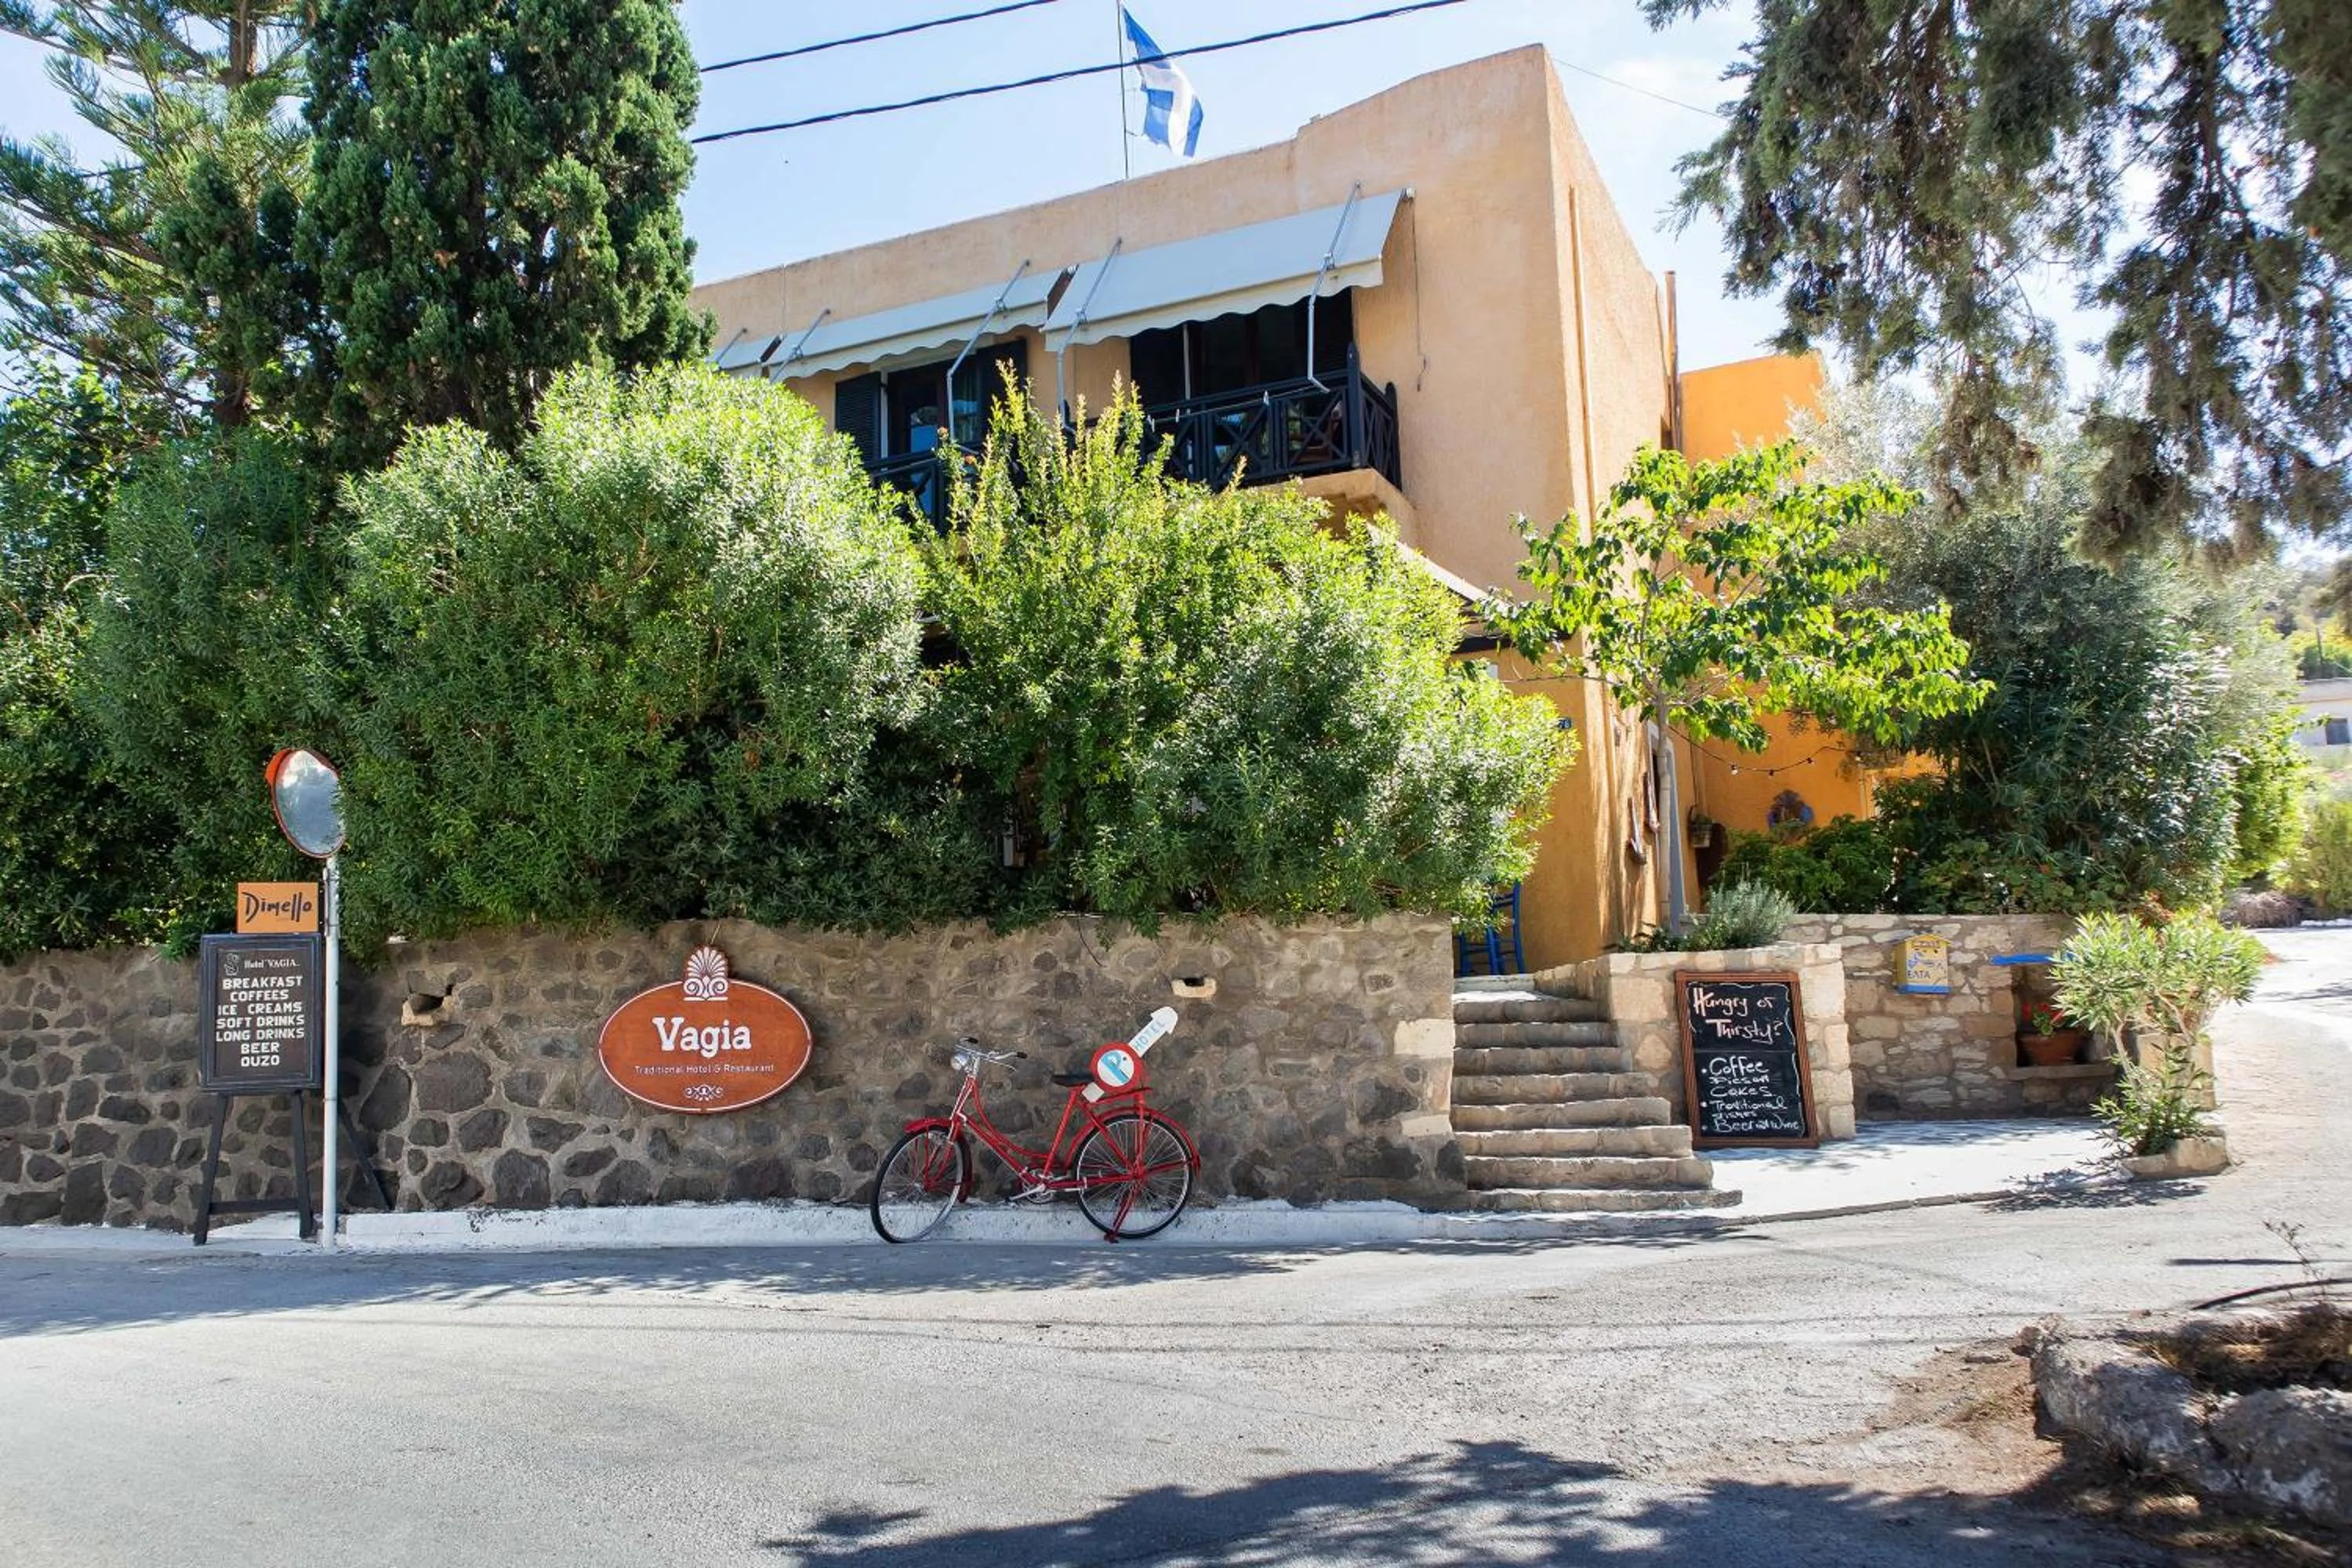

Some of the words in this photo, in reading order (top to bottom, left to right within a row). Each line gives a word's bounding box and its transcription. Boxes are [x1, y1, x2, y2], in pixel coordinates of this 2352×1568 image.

[241, 891, 313, 923] Dimello
[244, 959, 264, 969] Hotel
[222, 976, 303, 989] BREAKFAST
[230, 989, 289, 1002] COFFEES
[1693, 987, 1748, 1017] Hungry
[1757, 996, 1777, 1009] or
[217, 1004, 238, 1015] ICE
[247, 1002, 302, 1014] CREAMS
[216, 1018, 252, 1029] SOFT
[256, 1014, 305, 1027] DRINKS
[216, 1030, 251, 1042] LONG
[256, 1028, 305, 1040] DRINKS
[652, 1016, 752, 1058] Vagia
[1705, 1018, 1784, 1044] Thirsty?
[241, 1042, 281, 1054] BEER
[241, 1054, 281, 1067] OUZO
[1708, 1055, 1769, 1077] Coffee
[634, 1065, 683, 1075] Traditional
[686, 1065, 711, 1074] Hotel
[724, 1063, 775, 1073] Restaurant
[1709, 1096, 1788, 1111] Traditional
[1714, 1117, 1755, 1133] Beer
